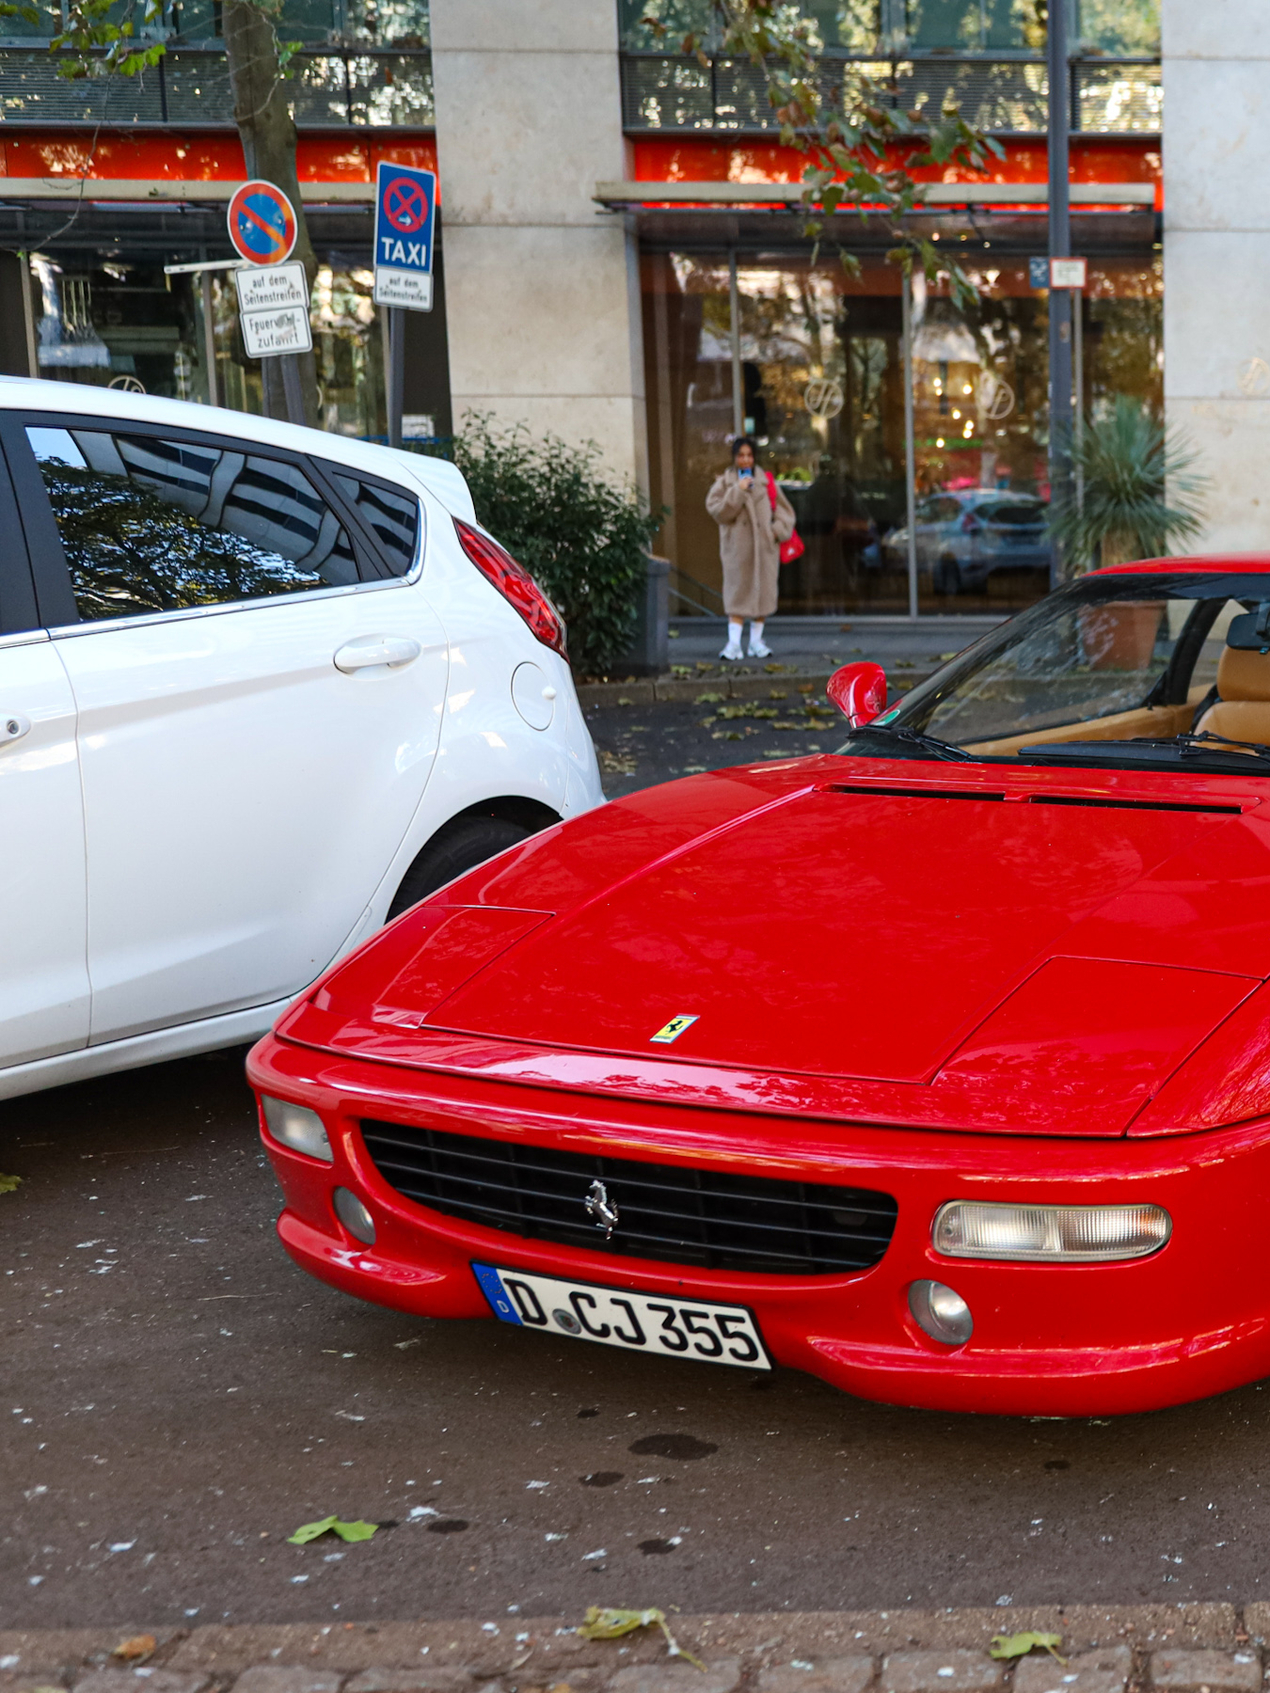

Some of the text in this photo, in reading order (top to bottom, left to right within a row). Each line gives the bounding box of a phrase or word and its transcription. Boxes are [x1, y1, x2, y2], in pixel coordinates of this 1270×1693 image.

[381, 236, 427, 267] TAXI
[252, 273, 288, 289] auf dem
[243, 289, 303, 307] Seitenstreifen
[501, 1277, 760, 1363] D CJ 355
